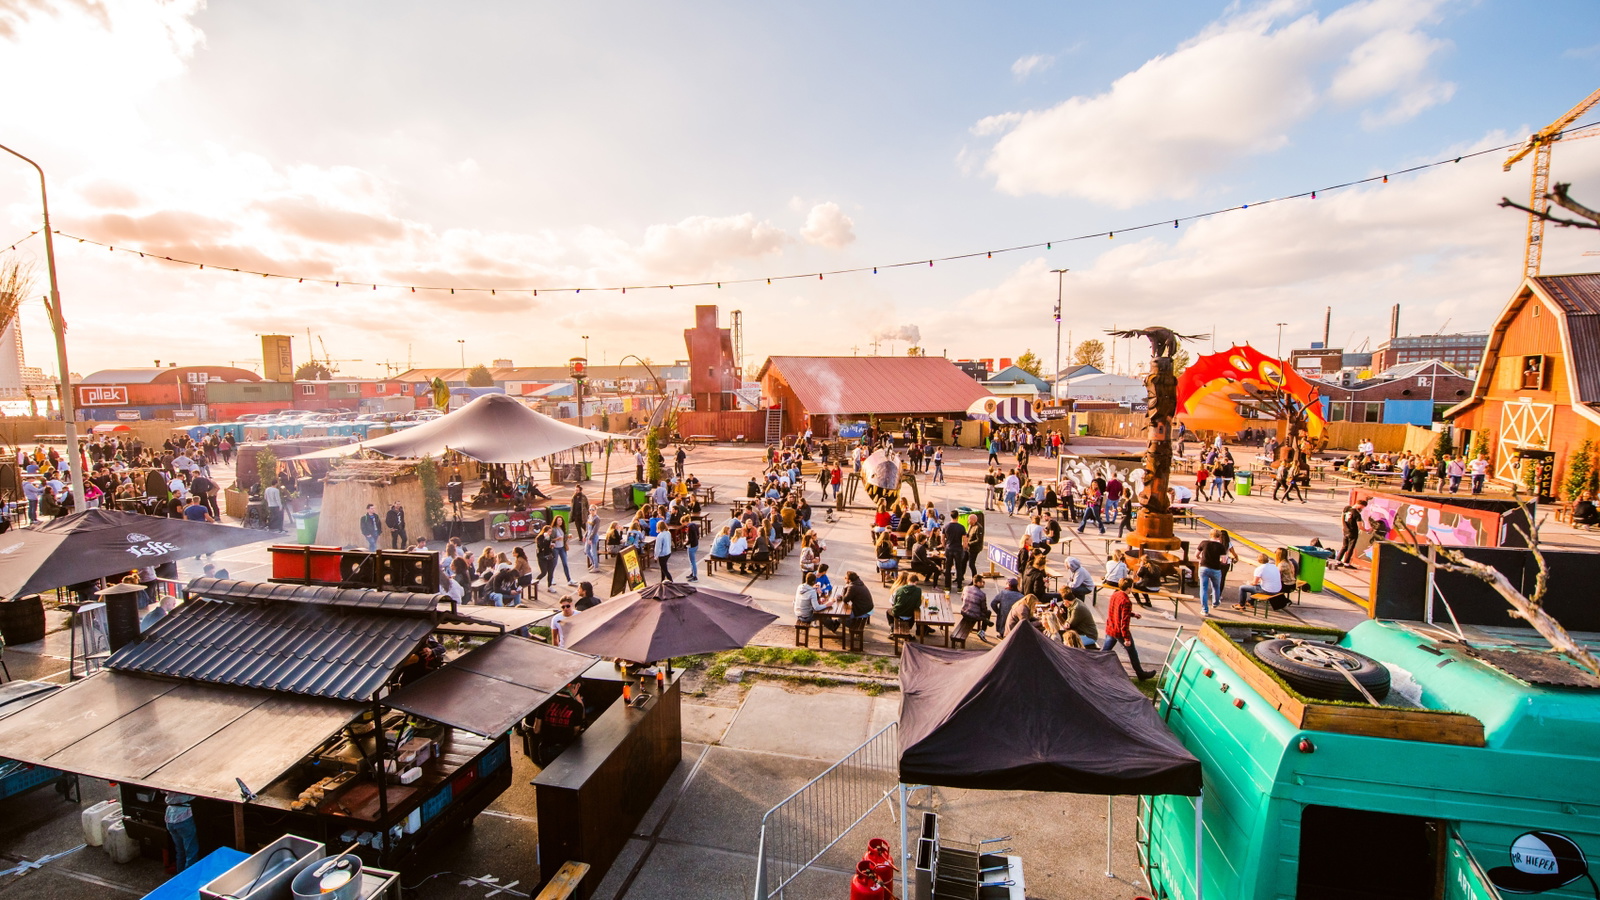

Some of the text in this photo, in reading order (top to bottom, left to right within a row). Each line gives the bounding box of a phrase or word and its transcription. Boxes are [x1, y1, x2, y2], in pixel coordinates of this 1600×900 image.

[88, 388, 121, 404] pllek
[1540, 455, 1554, 497] BOXER
[126, 541, 174, 558] Leffe
[989, 545, 1019, 573] KOFFIE
[1512, 852, 1556, 871] MR HIEPER
